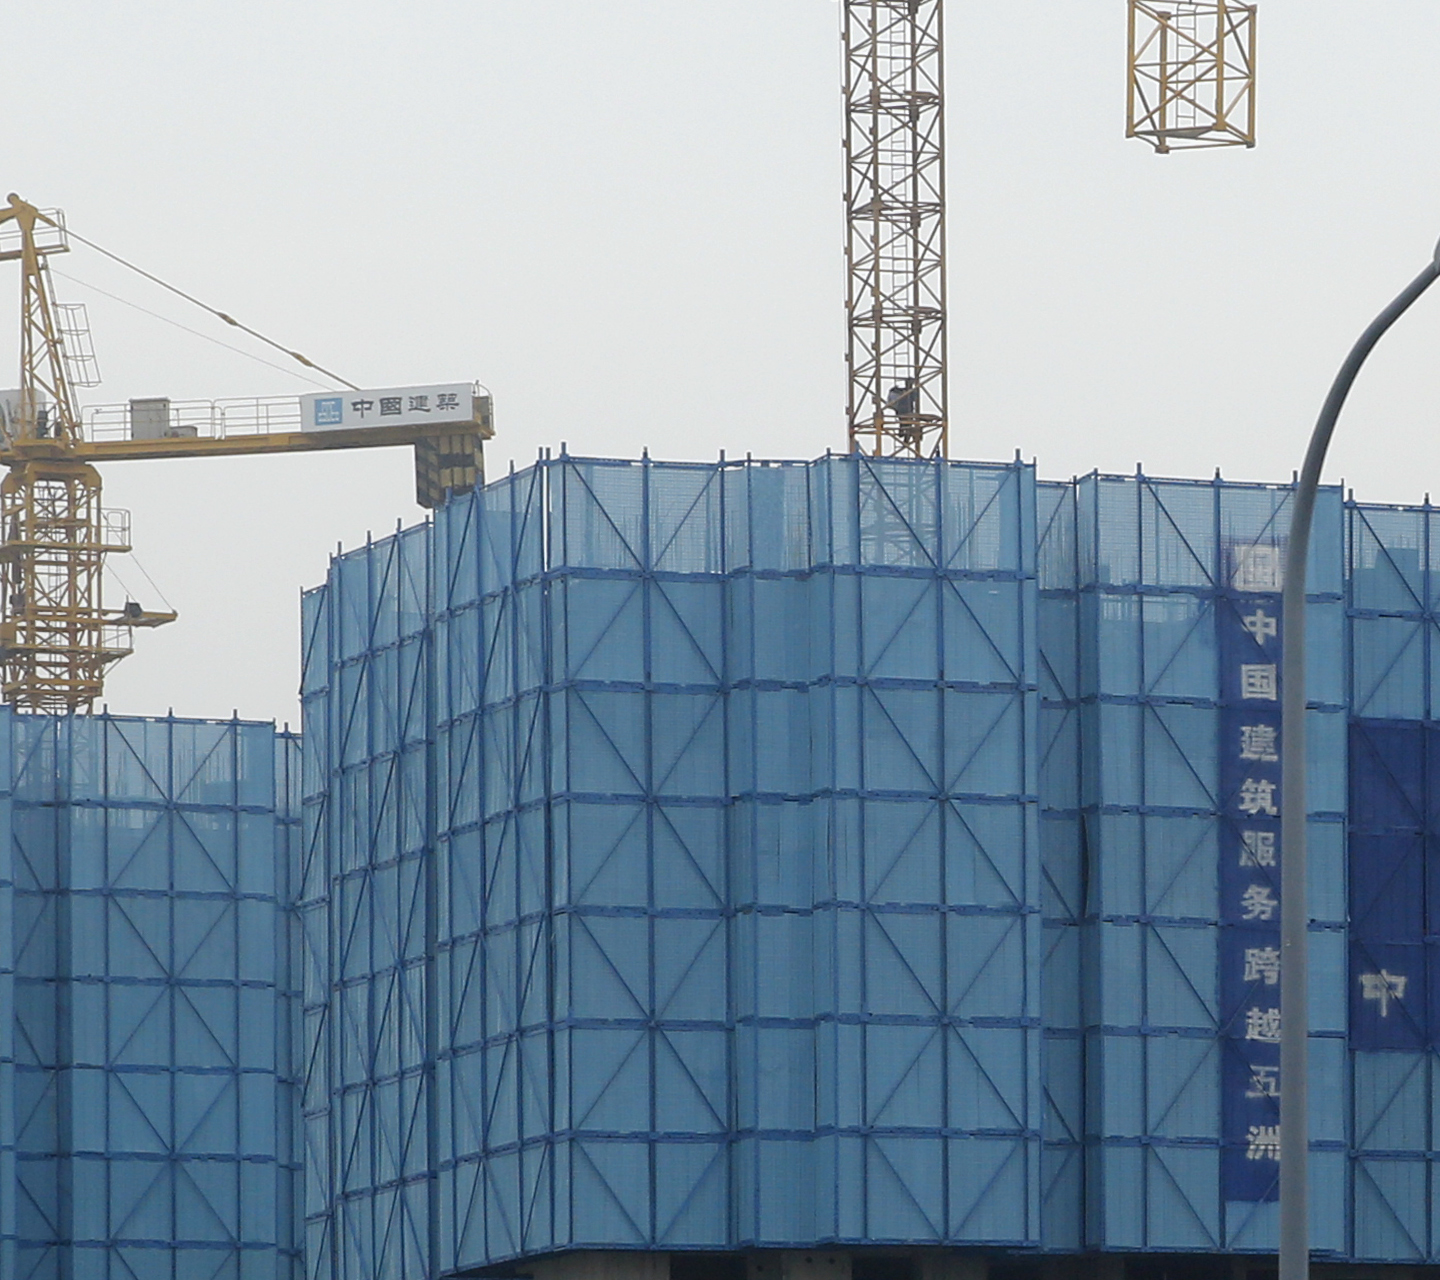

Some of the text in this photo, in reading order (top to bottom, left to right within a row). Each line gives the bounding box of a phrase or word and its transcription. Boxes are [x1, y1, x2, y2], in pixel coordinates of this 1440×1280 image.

[350, 392, 460, 419] 中國建築
[1240, 608, 1282, 1161] 中国建筑服务跨越五洲
